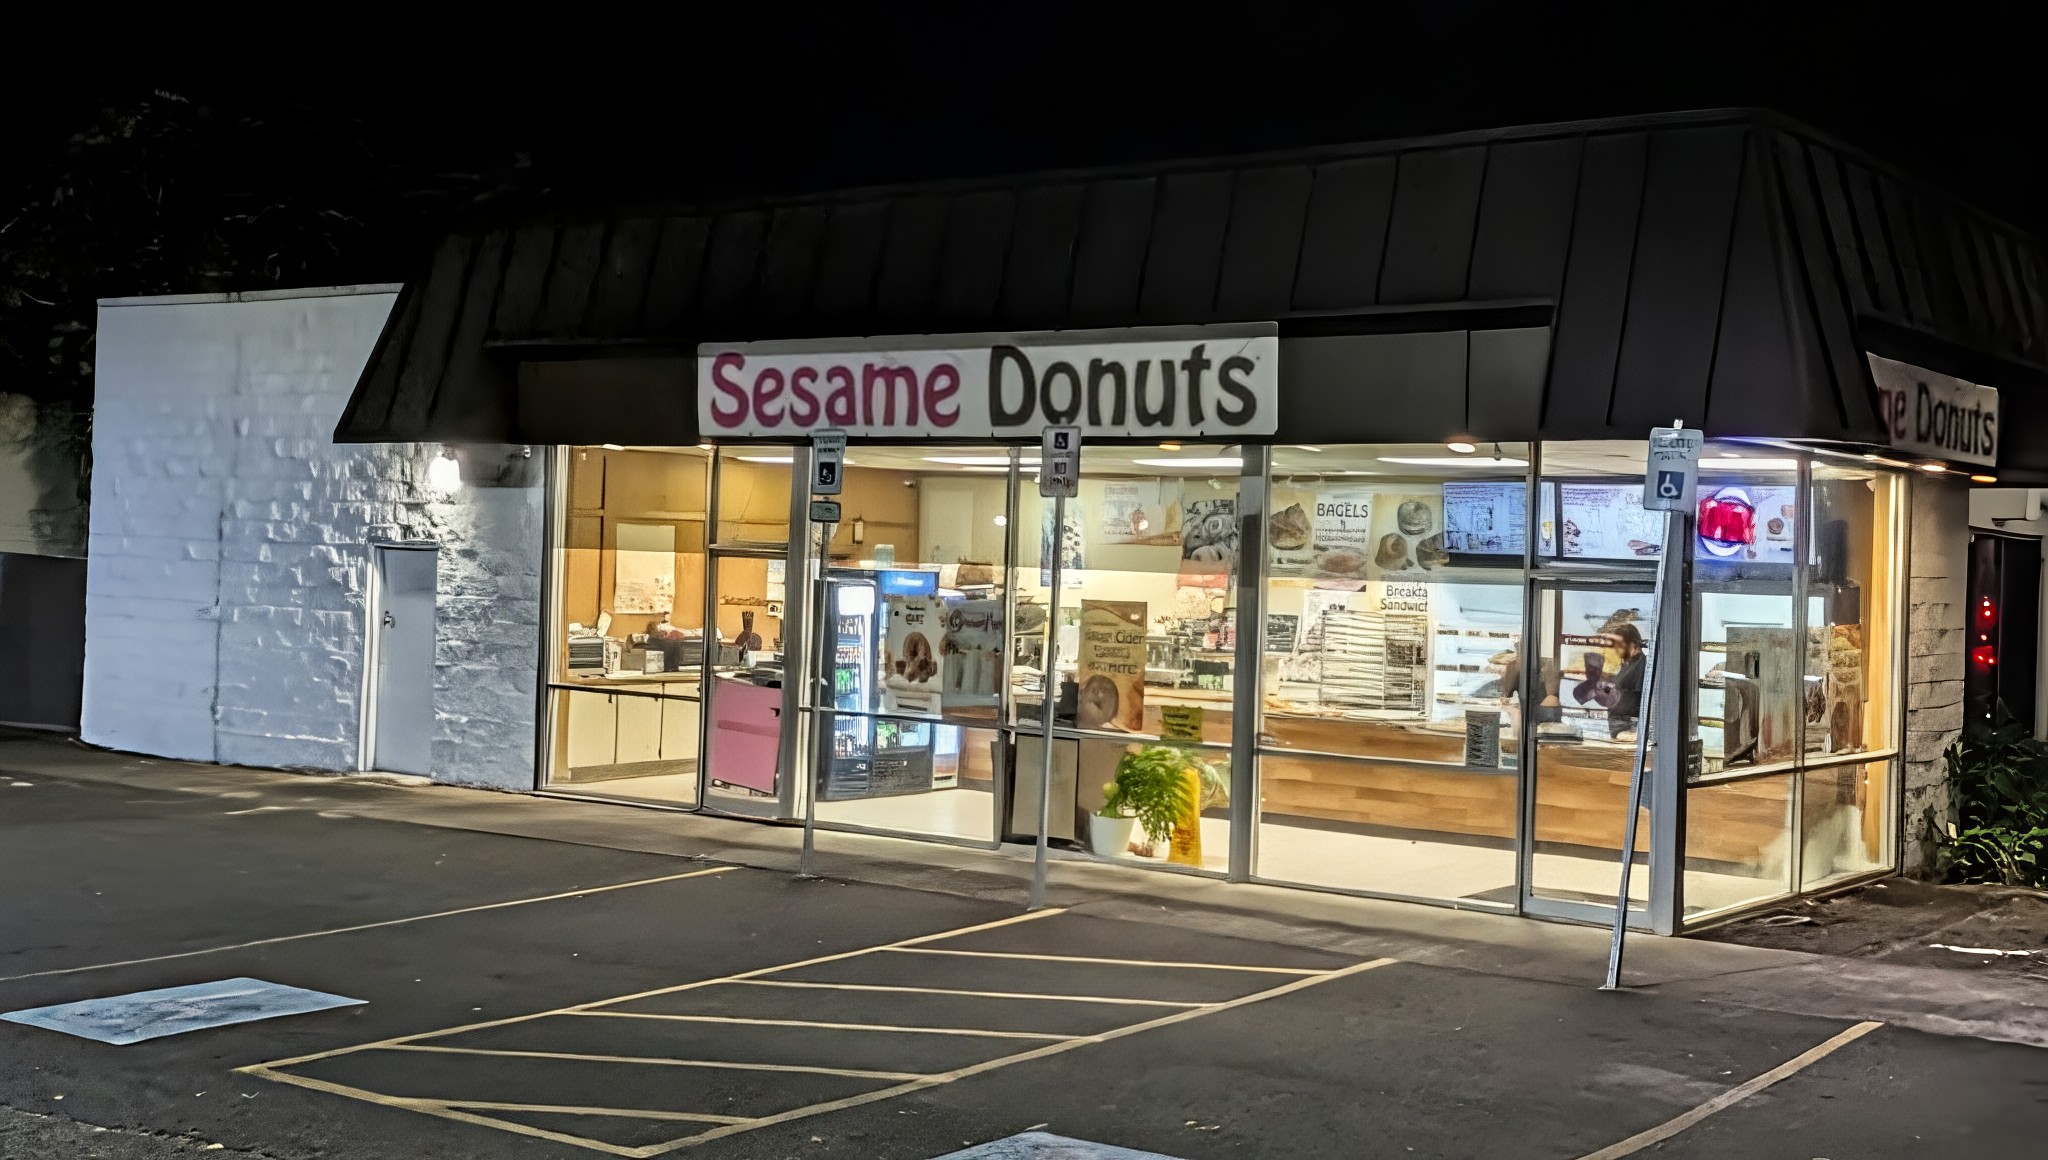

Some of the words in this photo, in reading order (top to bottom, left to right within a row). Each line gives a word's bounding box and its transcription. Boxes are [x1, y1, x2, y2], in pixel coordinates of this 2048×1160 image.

[711, 352, 961, 428] Sesame
[988, 344, 1258, 428] Donuts
[1916, 381, 1995, 456] Donuts
[1317, 503, 1369, 518] BAGELS
